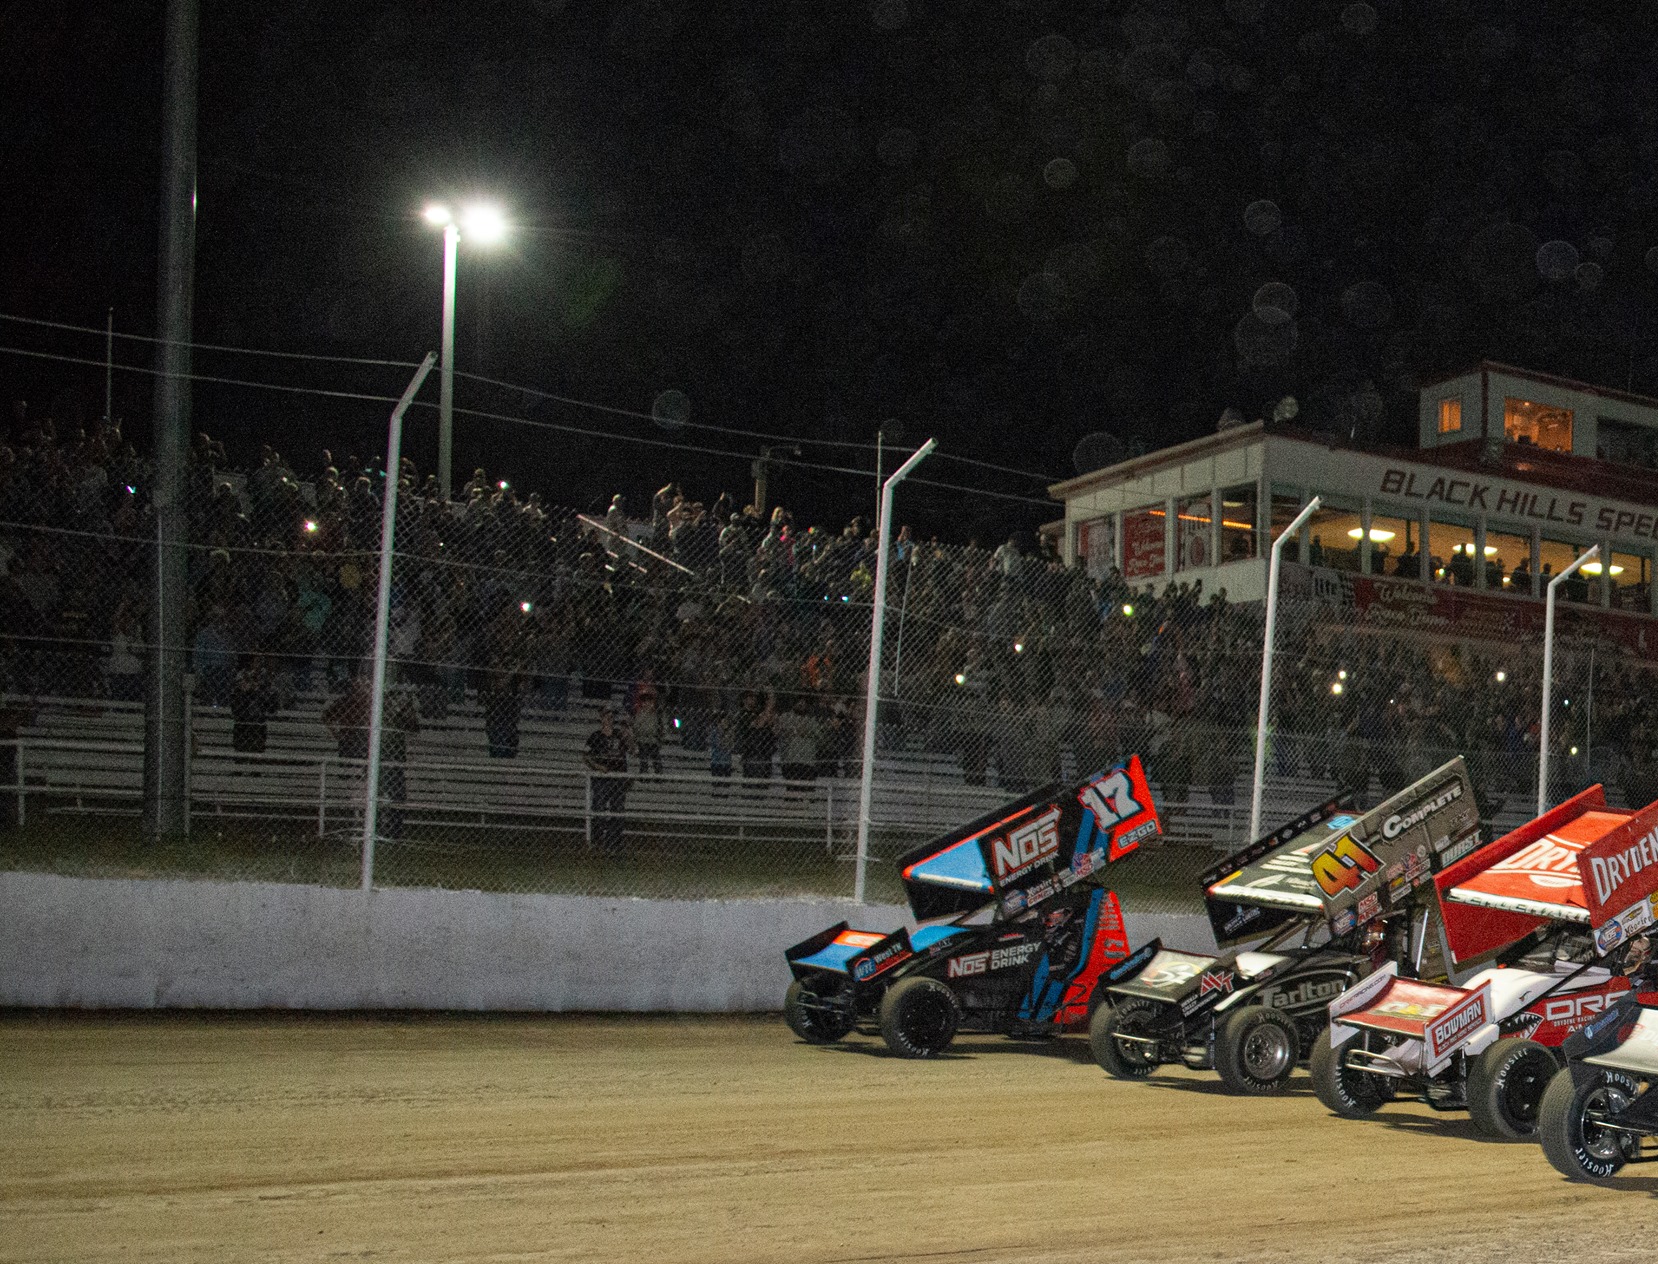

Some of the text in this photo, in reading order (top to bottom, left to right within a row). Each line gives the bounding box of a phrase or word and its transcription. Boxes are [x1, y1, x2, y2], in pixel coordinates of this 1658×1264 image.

[1379, 469, 1490, 510] BLACK
[1496, 489, 1587, 525] HILLS
[1079, 769, 1143, 831] 17
[1384, 785, 1462, 839] COMPLETE
[994, 805, 1061, 877] NOS
[1119, 822, 1156, 847] EZGO
[1000, 850, 1060, 887] ENERGY DRINK
[1312, 835, 1385, 897] 41
[948, 951, 991, 979] NOS
[991, 941, 1042, 960] ENERGY
[991, 954, 1030, 971] DRINK
[1256, 979, 1345, 1009] Tarlton
[1435, 999, 1482, 1046] BOWMAN
[1494, 1047, 1528, 1090] Hoosier
[1574, 1147, 1614, 1178] Hoosier
